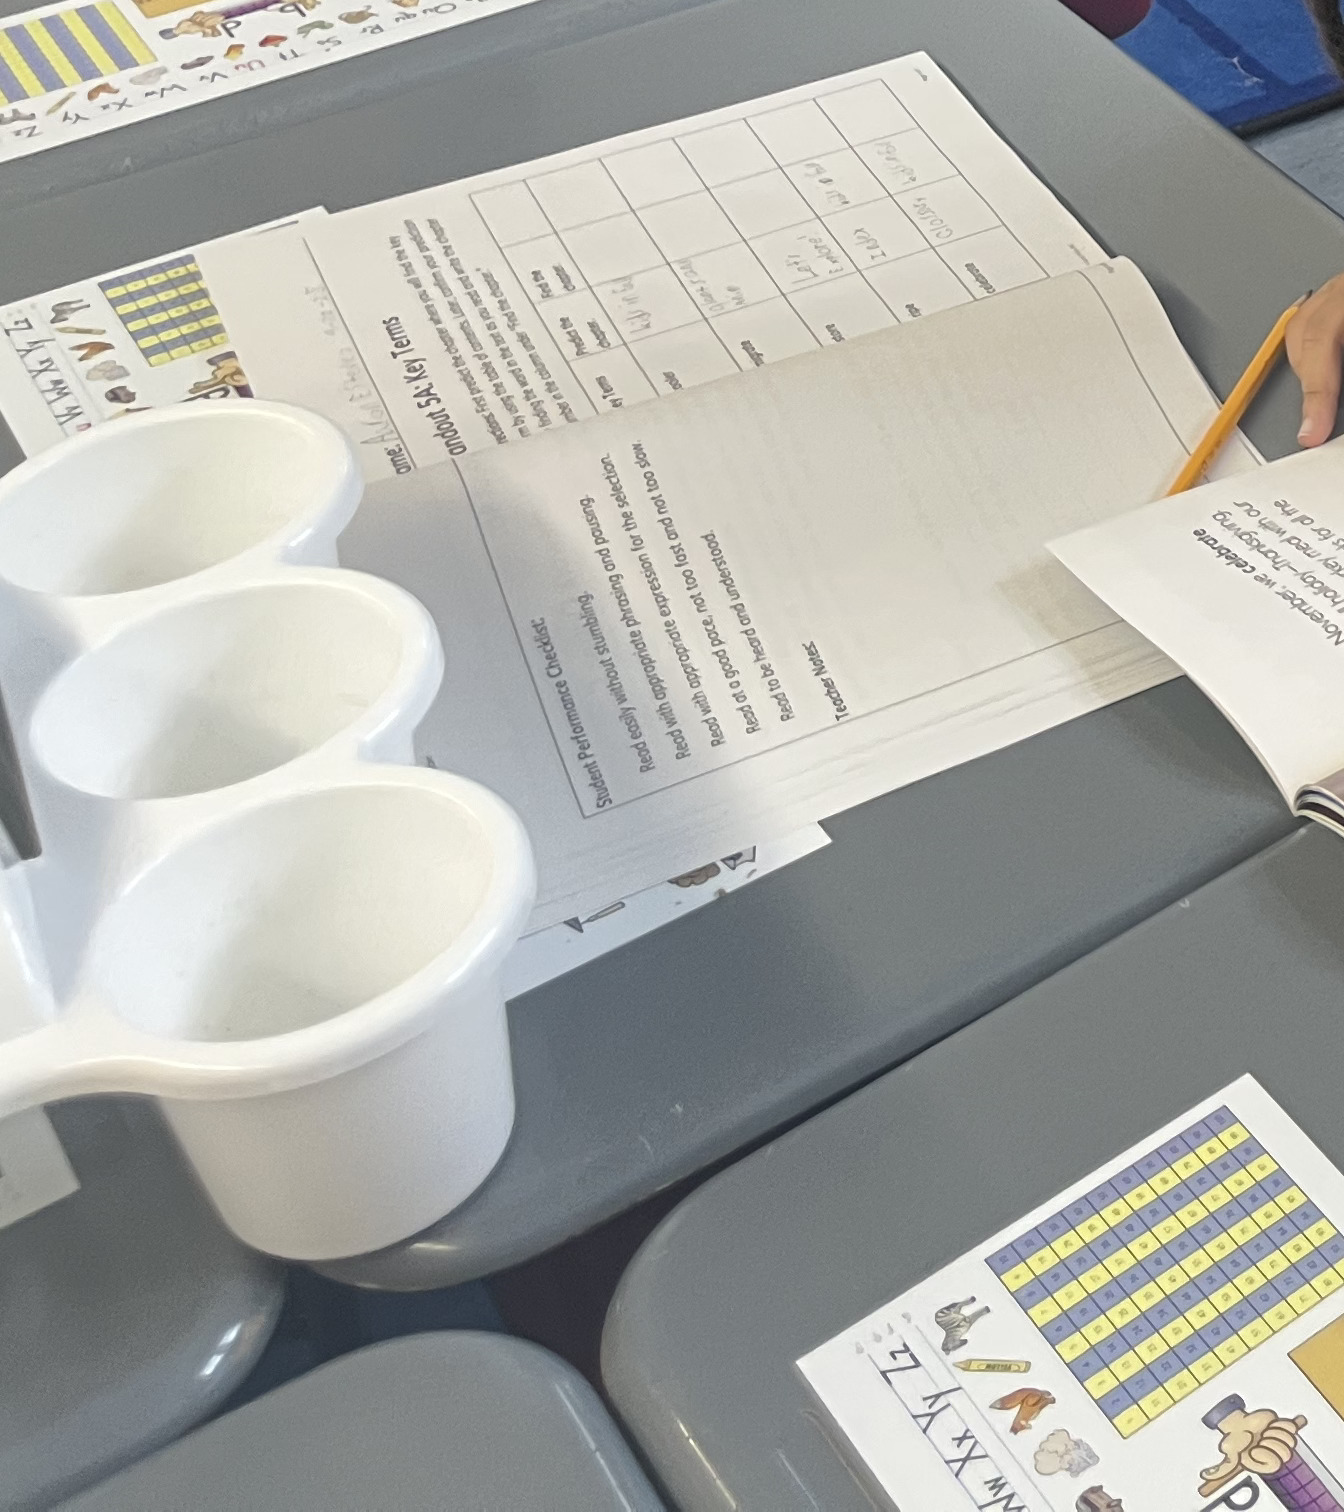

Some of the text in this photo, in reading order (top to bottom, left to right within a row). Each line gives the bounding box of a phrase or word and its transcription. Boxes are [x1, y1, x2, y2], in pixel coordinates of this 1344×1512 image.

[382, 317, 414, 359] Terms
[426, 408, 467, 455] andout
[621, 511, 637, 532] the
[595, 548, 616, 572] and
[629, 535, 644, 552] for
[1193, 529, 1256, 573] celebrate
[609, 574, 641, 628] phrasing
[638, 553, 671, 617] expression
[643, 471, 761, 734] Read good not too fast and not too
[730, 603, 751, 626] and
[664, 620, 701, 689] appropriate
[740, 628, 766, 663] heard
[599, 657, 628, 705] without
[630, 630, 667, 700] appropriate
[656, 702, 677, 728] with
[692, 691, 712, 716] with
[771, 692, 794, 722] Read
[821, 678, 849, 721] Teacher
[619, 707, 643, 740] easily
[702, 717, 725, 747] Read
[555, 680, 614, 810] Student Performance
[630, 741, 655, 773] Read
[666, 729, 691, 760] Read
